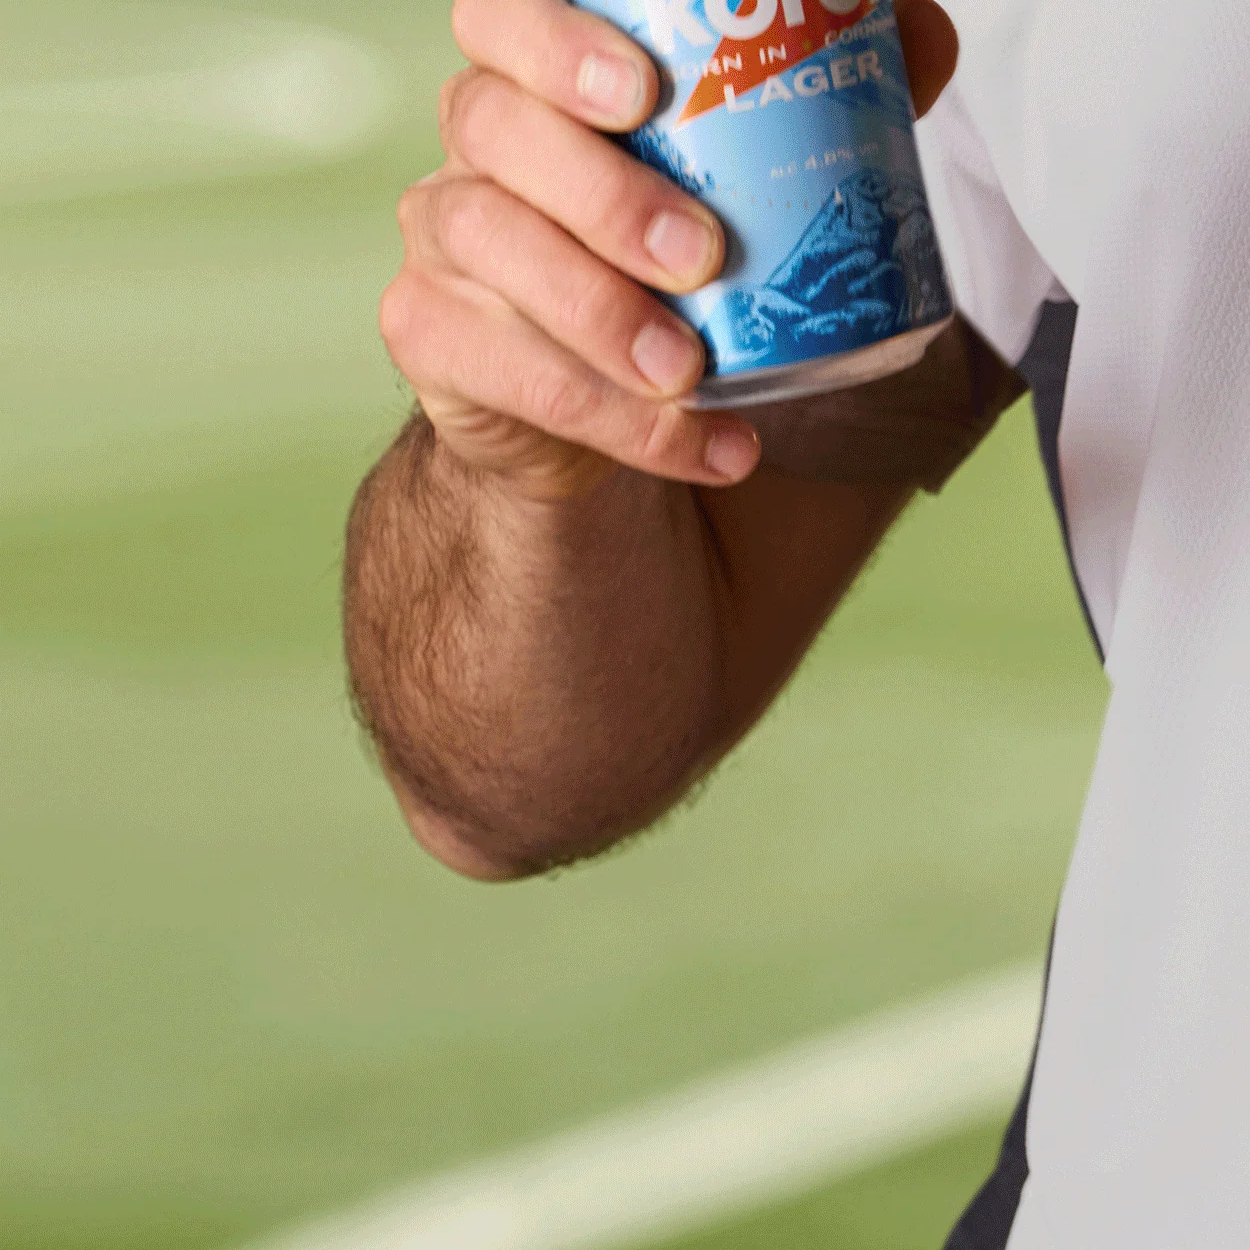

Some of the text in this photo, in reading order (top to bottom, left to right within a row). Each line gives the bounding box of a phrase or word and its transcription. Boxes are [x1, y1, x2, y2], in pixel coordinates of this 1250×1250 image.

[679, 53, 742, 79] ORN
[759, 44, 787, 66] IN
[723, 50, 883, 114] LAGER
